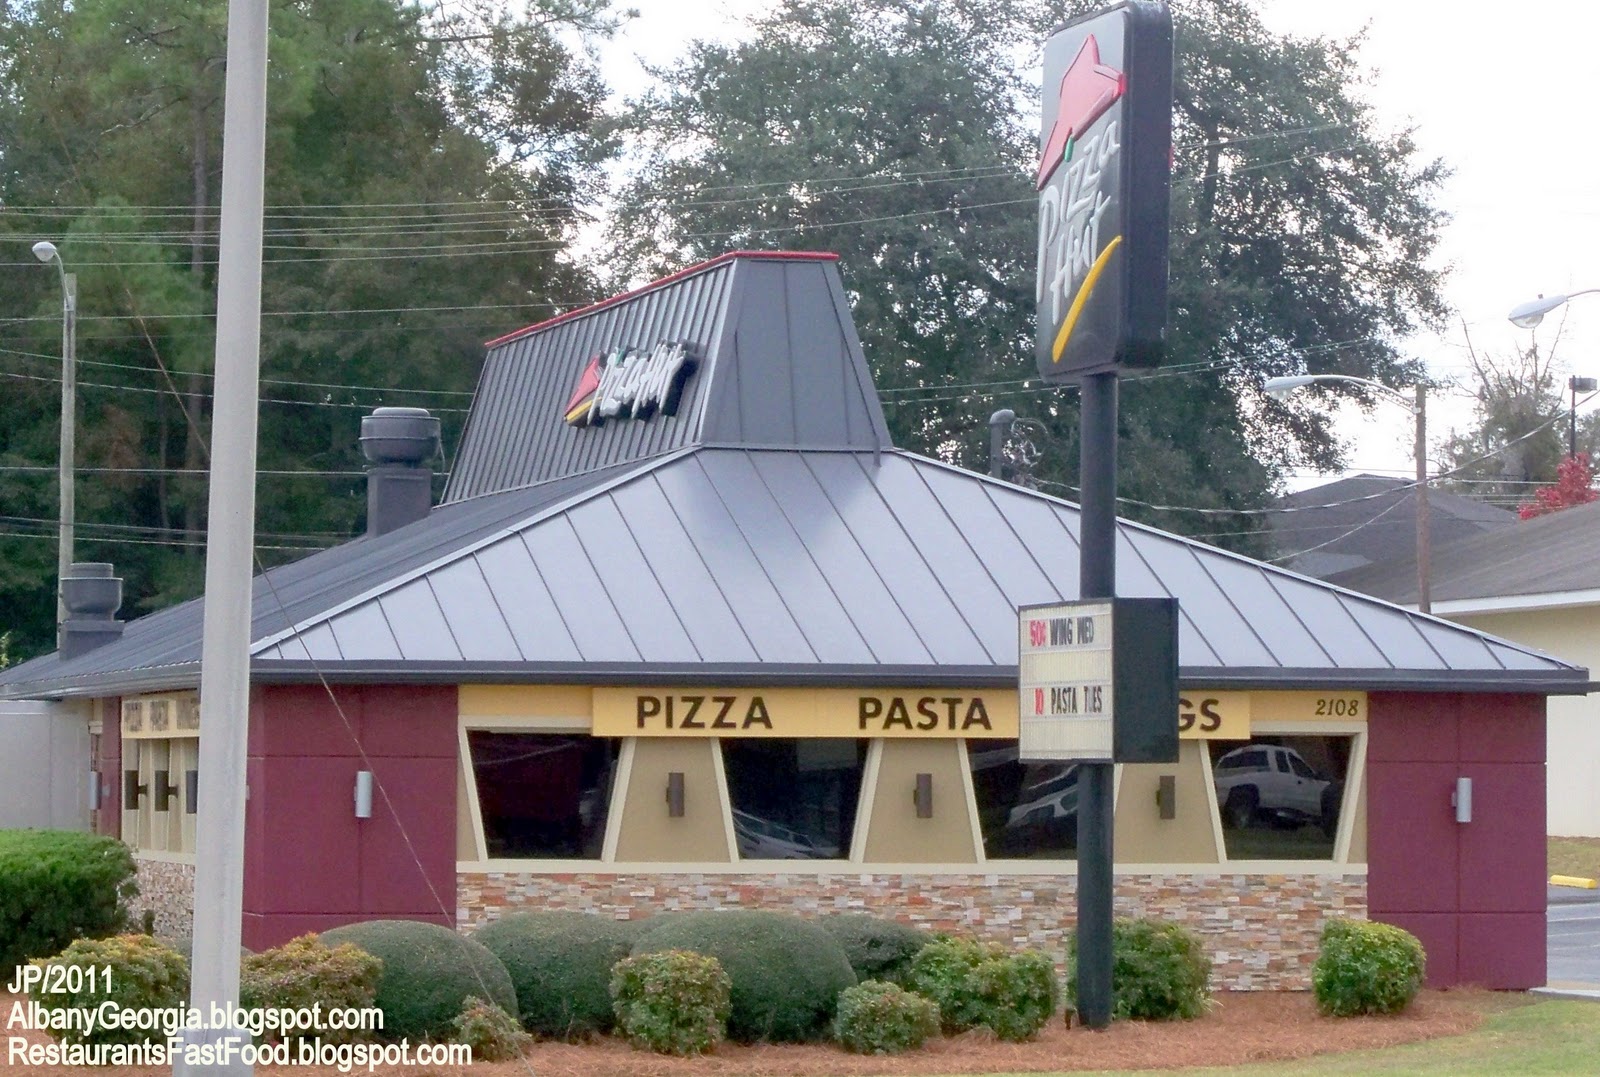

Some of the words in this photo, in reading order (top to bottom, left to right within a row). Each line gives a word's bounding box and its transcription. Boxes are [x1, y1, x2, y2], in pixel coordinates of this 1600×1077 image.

[1036, 121, 1120, 303] Pizza
[1050, 191, 1111, 326] Hut
[637, 696, 772, 729] PIZZA
[858, 697, 992, 730] PASTA
[1051, 687, 1077, 714] PASTA
[1315, 699, 1358, 716] 2108
